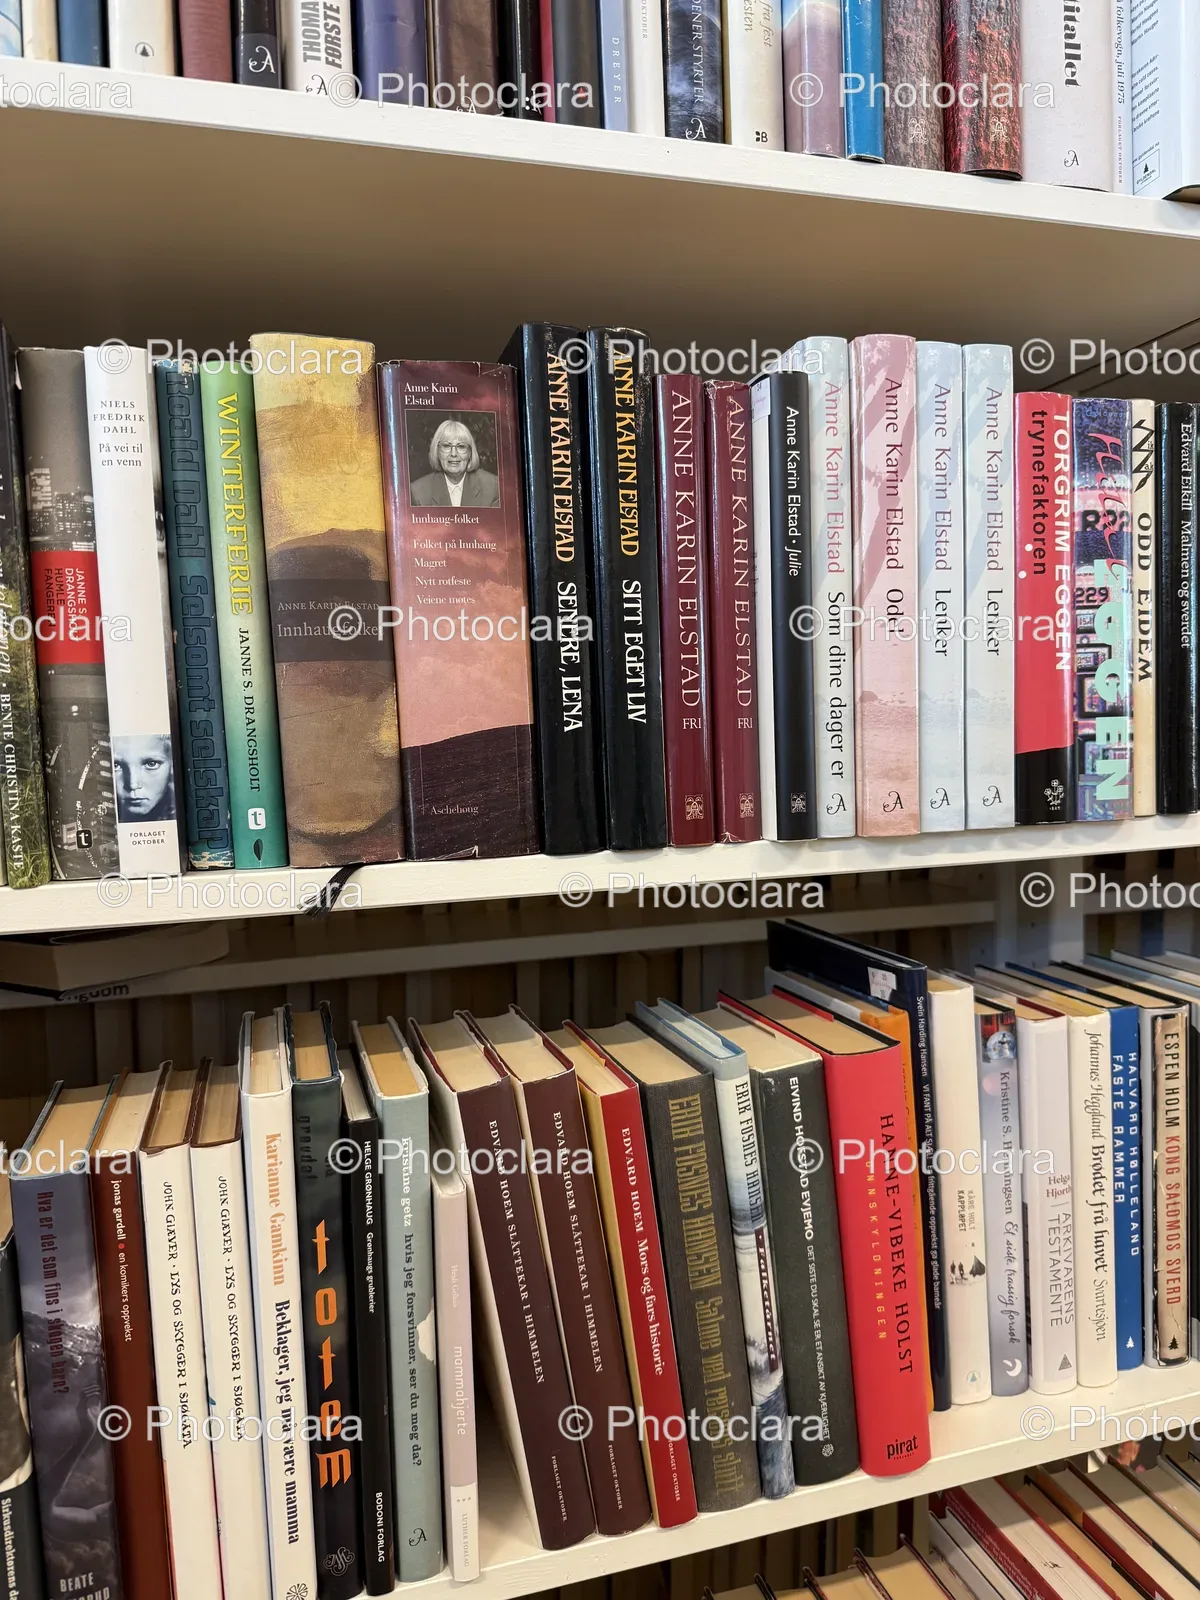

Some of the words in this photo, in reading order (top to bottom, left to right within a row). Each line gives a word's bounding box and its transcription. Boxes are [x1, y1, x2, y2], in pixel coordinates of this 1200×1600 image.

[323, 2, 342, 69] FØRSTE
[611, 37, 622, 103] DREYER
[693, 45, 705, 103] STYRTER
[1115, 59, 1125, 79] juli
[1117, 81, 1125, 104] 1975
[100, 400, 135, 408] NIELS
[404, 382, 429, 393] Anne
[432, 383, 458, 394] Karin
[404, 395, 435, 406] Elstad
[825, 381, 842, 437] Anne
[885, 378, 903, 433] Anne
[934, 384, 951, 438] Anne
[986, 386, 1002, 440] Anne
[93, 414, 145, 422] FREDRIK
[103, 426, 136, 434] DAHL
[166, 371, 200, 472] Roald
[672, 391, 693, 478] ANNE
[726, 395, 747, 482] ANNE
[786, 406, 799, 445] Anne
[99, 443, 110, 453] På
[114, 443, 129, 453] vei
[132, 443, 143, 453] til
[551, 416, 573, 490] KARIN
[616, 412, 637, 485] KARIN
[787, 451, 801, 489] Karin
[885, 443, 904, 497] Karin
[826, 447, 843, 501] Karin
[935, 448, 952, 500] Karin
[986, 450, 1003, 501] Karin
[1028, 410, 1049, 575] trynefaktoren
[1053, 410, 1070, 552] TORGRIM
[173, 480, 205, 558] Dahl
[217, 393, 253, 615] WINTERFERIE
[411, 514, 480, 525] Innhaug-folket
[553, 494, 575, 562] ELSTAD
[619, 489, 639, 556] ELSTAD
[788, 495, 801, 536] Elstad
[413, 539, 442, 549] Folket
[459, 540, 496, 550] Innhaug
[414, 558, 447, 569] Magret
[675, 491, 697, 585] KARIN
[732, 495, 748, 587] KARIN
[827, 511, 845, 574] Elstad
[886, 508, 904, 570] Elstad
[935, 511, 952, 571] Elstad
[987, 512, 1003, 571] Elstad
[1137, 513, 1152, 571] ODD
[76, 567, 86, 605] JANNE
[416, 595, 446, 604] Veiene
[448, 595, 475, 604] møtes
[438, 576, 471, 586] rotfeste
[827, 591, 845, 636] Som
[1055, 565, 1071, 670] EGGEN
[1137, 588, 1153, 682] EIDEM
[239, 628, 252, 676] JANNE
[624, 632, 645, 687] EGET
[679, 597, 701, 707] ELSTAD
[734, 600, 752, 707] ELSTAD
[829, 645, 847, 688] dine
[1, 693, 15, 740] BENTE
[561, 676, 583, 732] LENA
[683, 718, 702, 729] FRI
[737, 717, 752, 729] FRI
[825, 696, 847, 753] dager
[243, 696, 261, 792] DRANGSHOLT
[831, 760, 844, 779] er
[4, 743, 21, 825] CHRISTINA
[188, 719, 229, 850] selskap
[129, 830, 166, 838] FORLAGET
[430, 805, 479, 816] Aschehoug
[10, 825, 25, 869] KASTE
[916, 996, 926, 1017] Svein
[917, 1018, 928, 1048] Harding
[1084, 1030, 1103, 1082] Johannes
[1164, 1032, 1180, 1081] ESPEN
[920, 1049, 930, 1077] Hansen
[1113, 1055, 1124, 1110] FASTE
[790, 1076, 802, 1123] EIVIND
[1000, 1072, 1012, 1122] Kristine
[1084, 1084, 1105, 1140] Heggland
[1165, 1087, 1180, 1128] HOLM
[364, 1140, 372, 1171] HELGE
[1165, 1136, 1180, 1175] KONG
[111, 1180, 122, 1206] jonas
[163, 1181, 174, 1210] JOHN
[218, 1176, 229, 1206] JOHN
[365, 1171, 374, 1225] GRØNHAUG
[401, 1198, 411, 1227] getz
[563, 1170, 577, 1211] HOEM
[801, 1191, 814, 1240] EVJEMO
[957, 1190, 966, 1232] KAPPLØPET
[114, 1208, 126, 1240] gardell
[1166, 1183, 1181, 1251] SALOMOS
[269, 1212, 288, 1286] Gamkinn
[404, 1233, 414, 1264] hvis
[569, 1214, 591, 1291] SLÅTTEKAR
[621, 1127, 638, 1186] EDVARD
[631, 1190, 644, 1233] HOEM
[638, 1238, 650, 1275] Mors
[649, 1323, 666, 1376] historie
[880, 1113, 907, 1293] HANNE-VIBEKE
[895, 1303, 913, 1374] HOLST
[1063, 1212, 1074, 1325] ARKIVARENS
[170, 1271, 180, 1296] LYS
[225, 1266, 236, 1290] LYS
[500, 1179, 514, 1220] HOEM
[508, 1223, 530, 1306] SLÅTTEKAR
[525, 1315, 545, 1384] HIMMELEN
[808, 1262, 817, 1284] SISTE
[998, 1267, 1016, 1307] trassig
[1048, 1215, 1063, 1327] TESTAMENTE
[1166, 1258, 1181, 1305] SVERD
[121, 1304, 133, 1342] oppvekst
[695, 1295, 724, 1350] Salme
[811, 1295, 819, 1318] SKAL
[1001, 1309, 1021, 1344] forsøk
[1088, 1279, 1109, 1341] Svartesjøen
[173, 1320, 187, 1378] SKYGGER
[228, 1314, 241, 1376] SKYGGER
[273, 1299, 292, 1375] Beklager,
[315, 1219, 351, 1490] totem
[584, 1302, 603, 1373] HIMMELEN
[451, 1346, 469, 1435] mammahjerte
[816, 1352, 824, 1384] ANSIKT
[887, 1435, 918, 1459] pirat
[285, 1481, 299, 1545] mamma
[375, 1491, 383, 1529] BODONI
[377, 1530, 385, 1563] FORLAG
[60, 1572, 94, 1592] BEATE
